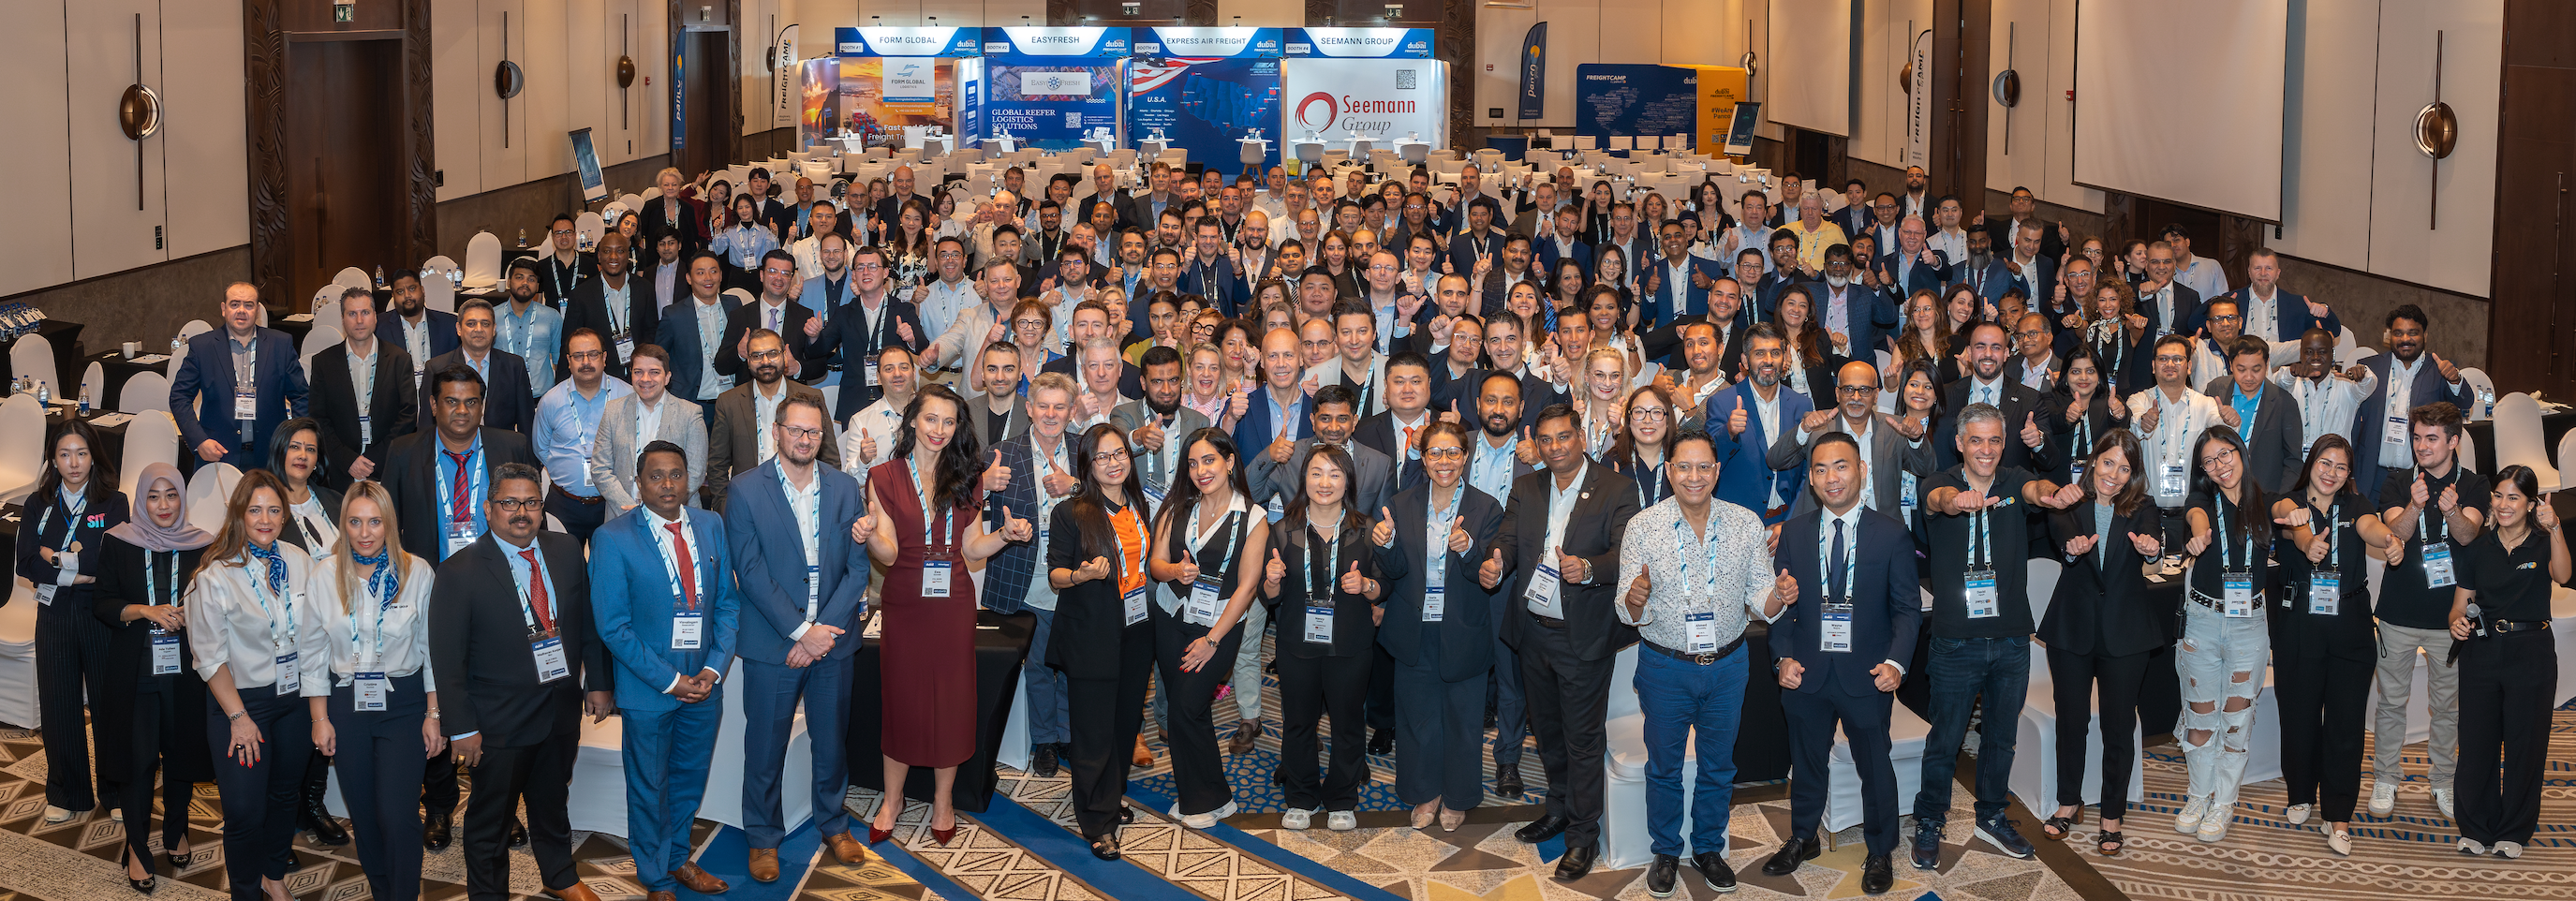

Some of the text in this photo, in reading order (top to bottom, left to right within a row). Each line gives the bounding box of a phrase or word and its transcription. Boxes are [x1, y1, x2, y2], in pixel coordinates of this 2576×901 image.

[1528, 64, 1537, 98] panco
[1343, 95, 1415, 114] Seemann
[1342, 116, 1391, 134] Group
[868, 133, 894, 142] Freight
[87, 513, 105, 528] SIT
